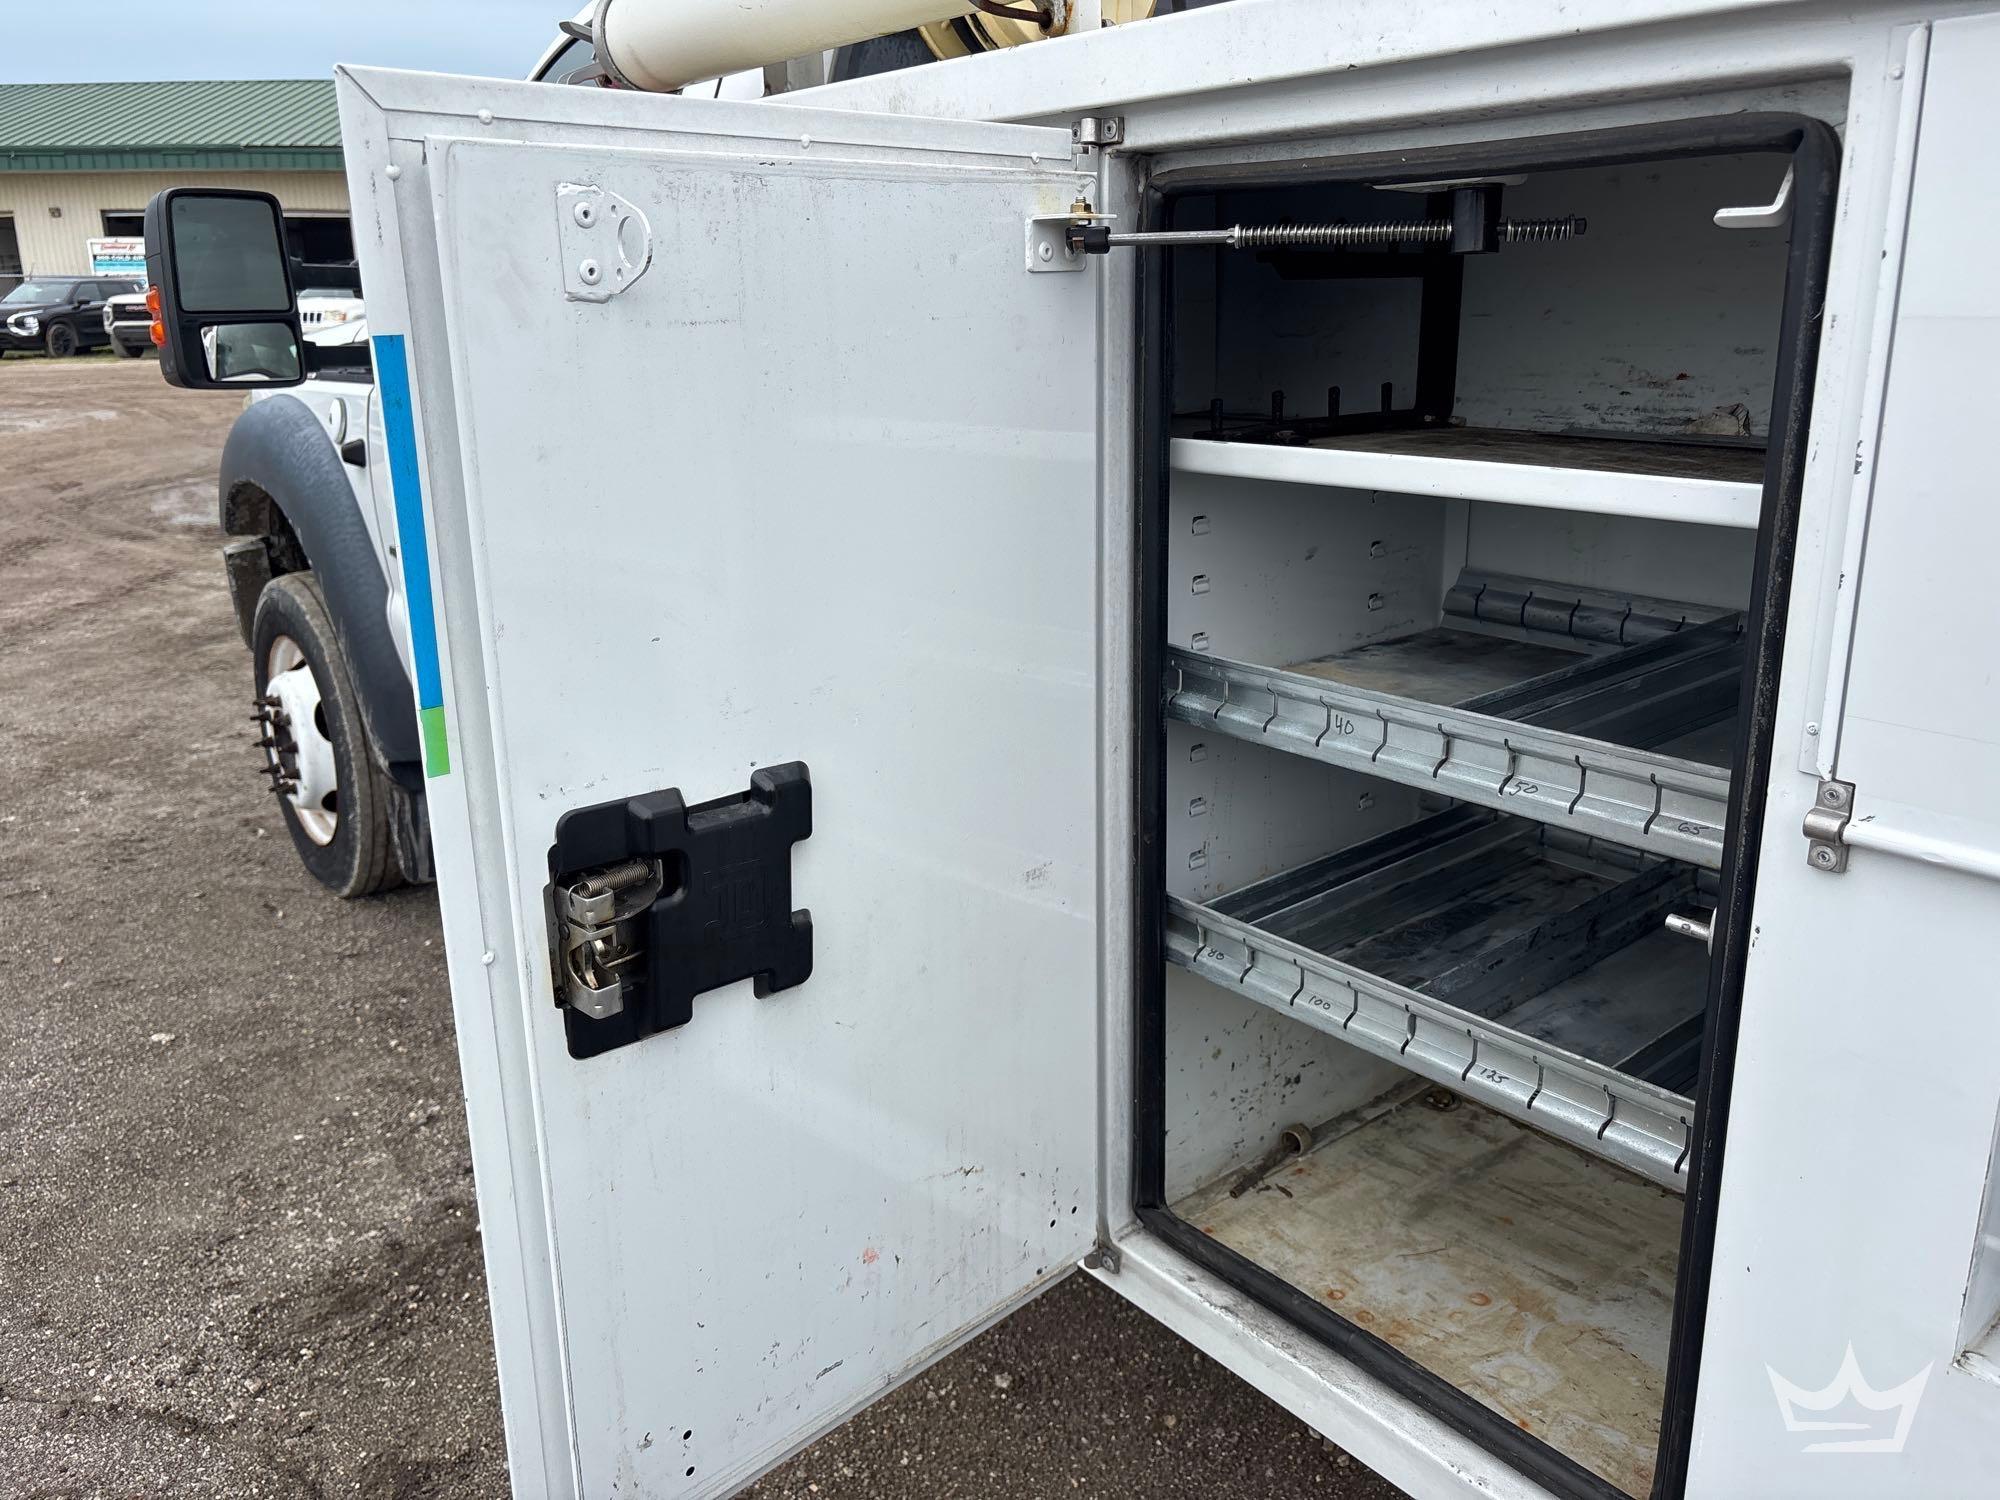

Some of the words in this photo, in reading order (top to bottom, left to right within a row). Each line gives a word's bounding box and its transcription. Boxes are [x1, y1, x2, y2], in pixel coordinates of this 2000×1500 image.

[1335, 714, 1354, 735] 40
[1508, 781, 1539, 796] 50
[1677, 822, 1710, 835] 65
[1207, 948, 1225, 961] 80
[1308, 995, 1331, 1010] 100
[1480, 1068, 1510, 1083] 125
